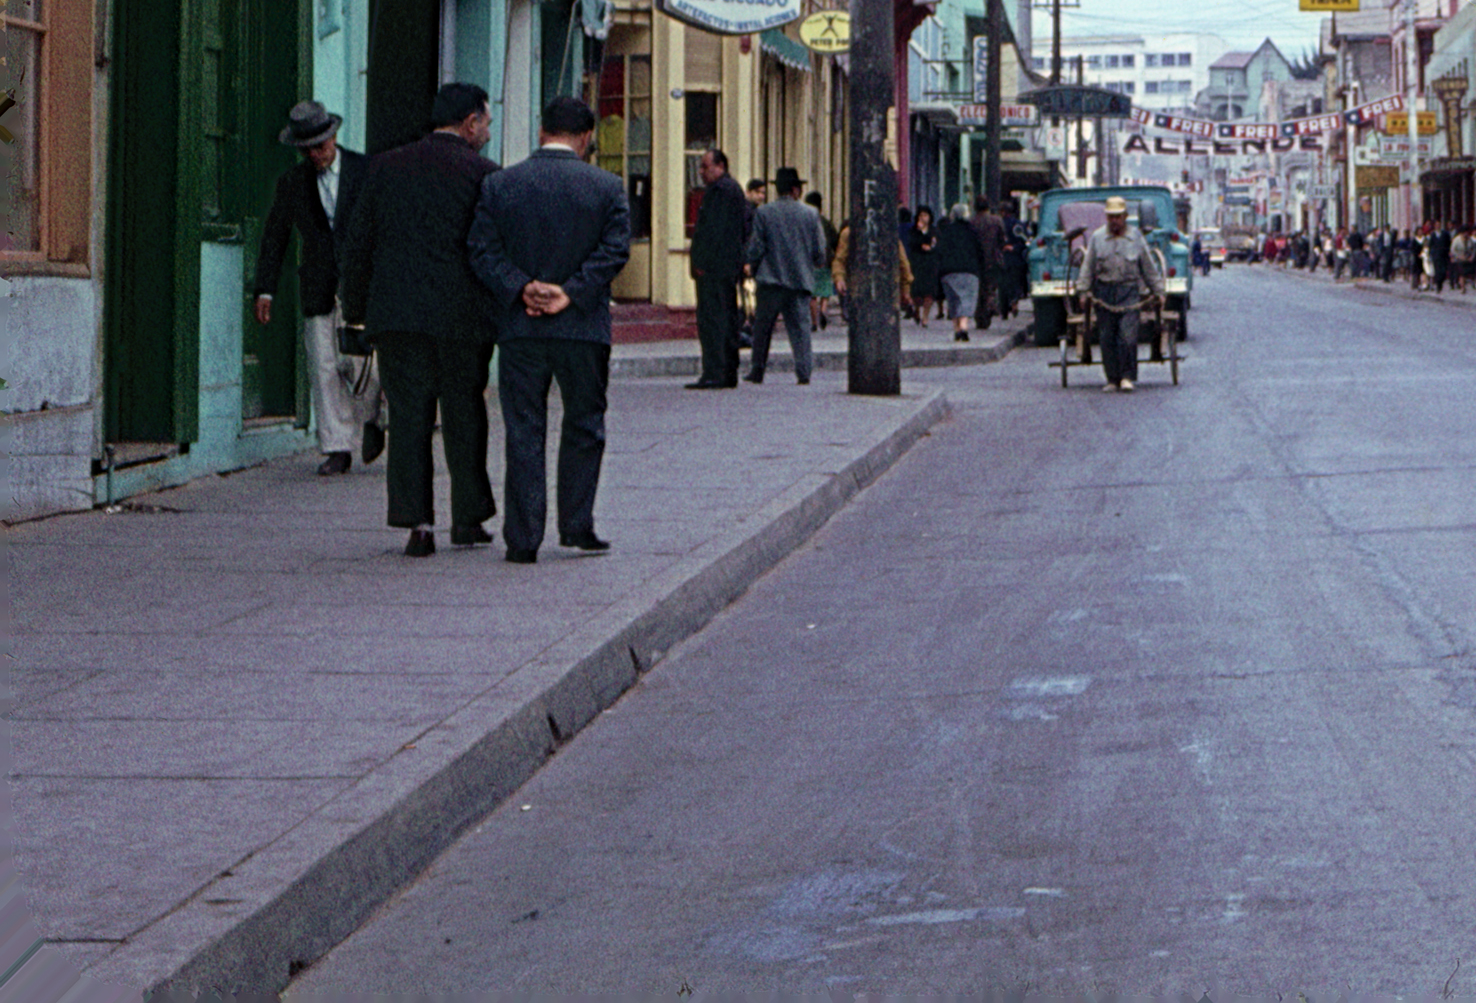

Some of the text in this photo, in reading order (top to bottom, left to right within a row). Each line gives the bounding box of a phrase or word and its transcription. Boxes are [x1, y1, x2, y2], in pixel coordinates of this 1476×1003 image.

[960, 105, 1031, 119] ELECONICO
[1361, 96, 1401, 120] FREI
[1171, 117, 1212, 136] FREI
[1235, 125, 1275, 138] FREI
[1299, 117, 1338, 134] FREI
[1123, 134, 1324, 155] ALLENDE
